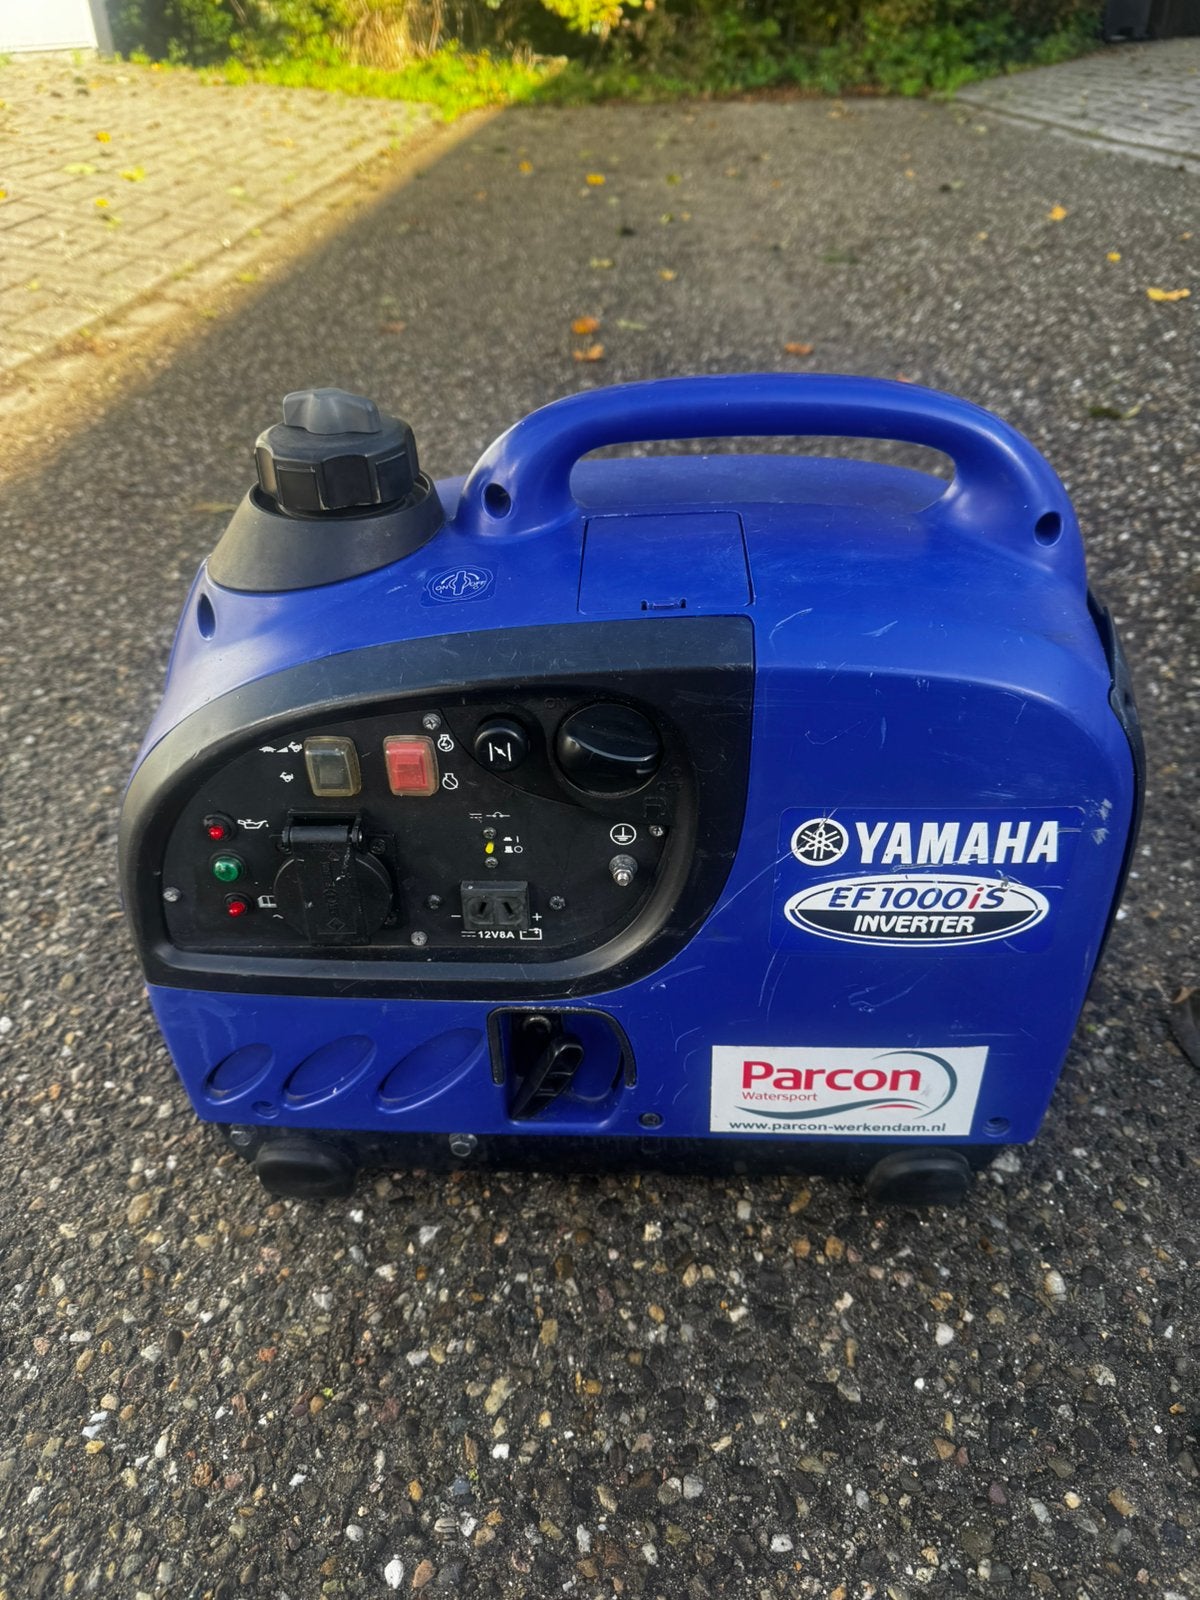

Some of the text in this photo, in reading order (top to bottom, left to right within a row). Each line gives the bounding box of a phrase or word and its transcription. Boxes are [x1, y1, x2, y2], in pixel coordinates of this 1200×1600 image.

[855, 821, 1059, 865] YAMAHA
[828, 886, 1006, 910] EF1000iS
[853, 914, 976, 934] INVERTER
[477, 930, 515, 939] 12V8A
[741, 1061, 922, 1091] Parcon
[741, 1091, 818, 1103] Watersport
[729, 1121, 947, 1133] www.parcon-werkendam.nl
